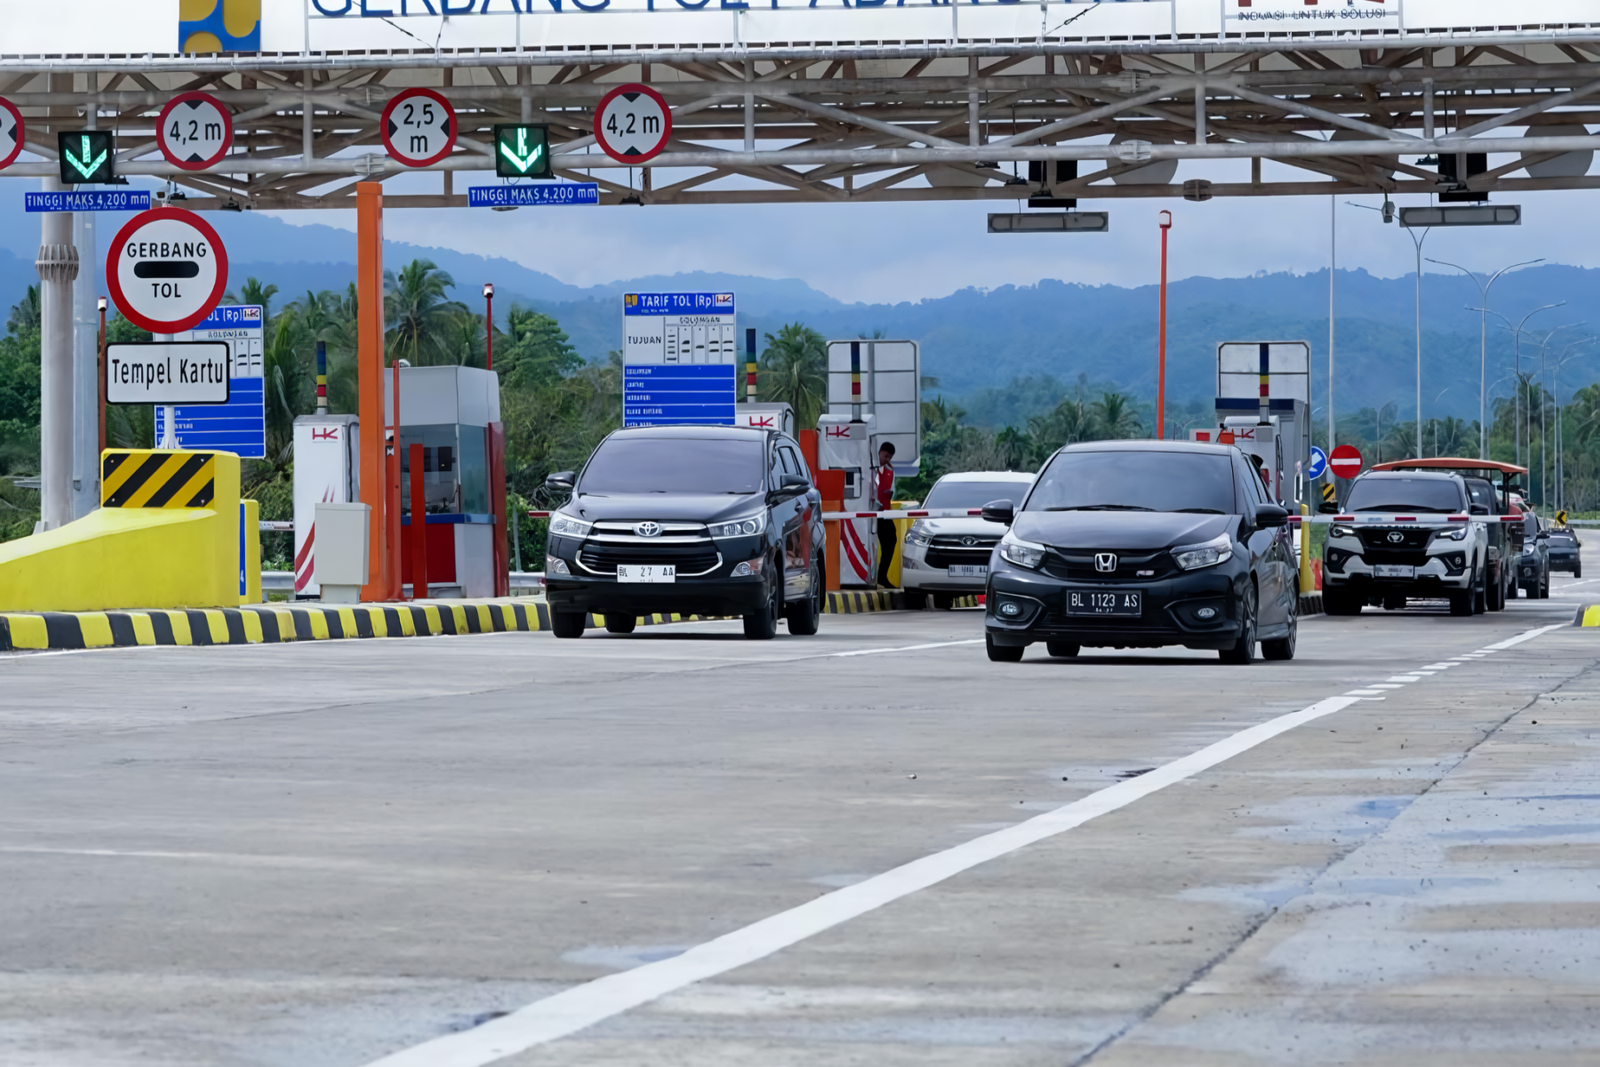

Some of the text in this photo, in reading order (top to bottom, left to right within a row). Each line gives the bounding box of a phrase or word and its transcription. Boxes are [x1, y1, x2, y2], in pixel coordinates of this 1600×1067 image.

[403, 103, 435, 129] 2,5
[169, 119, 222, 145] 4,2 m
[606, 112, 660, 137] 4,2 m
[410, 135, 428, 153] m
[27, 195, 63, 207] TINGGI
[66, 194, 94, 207] MAKS
[130, 195, 149, 205] mm
[471, 188, 508, 201] TINGGI
[511, 188, 540, 200] MAKS
[577, 188, 597, 198] mm
[126, 242, 207, 258] GERBANG
[151, 283, 182, 298] TOL
[641, 295, 669, 307] TARIF
[673, 295, 691, 307] TOL
[112, 357, 223, 390] Tempel Kartu
[1071, 593, 1138, 607] BL 1123 AS
